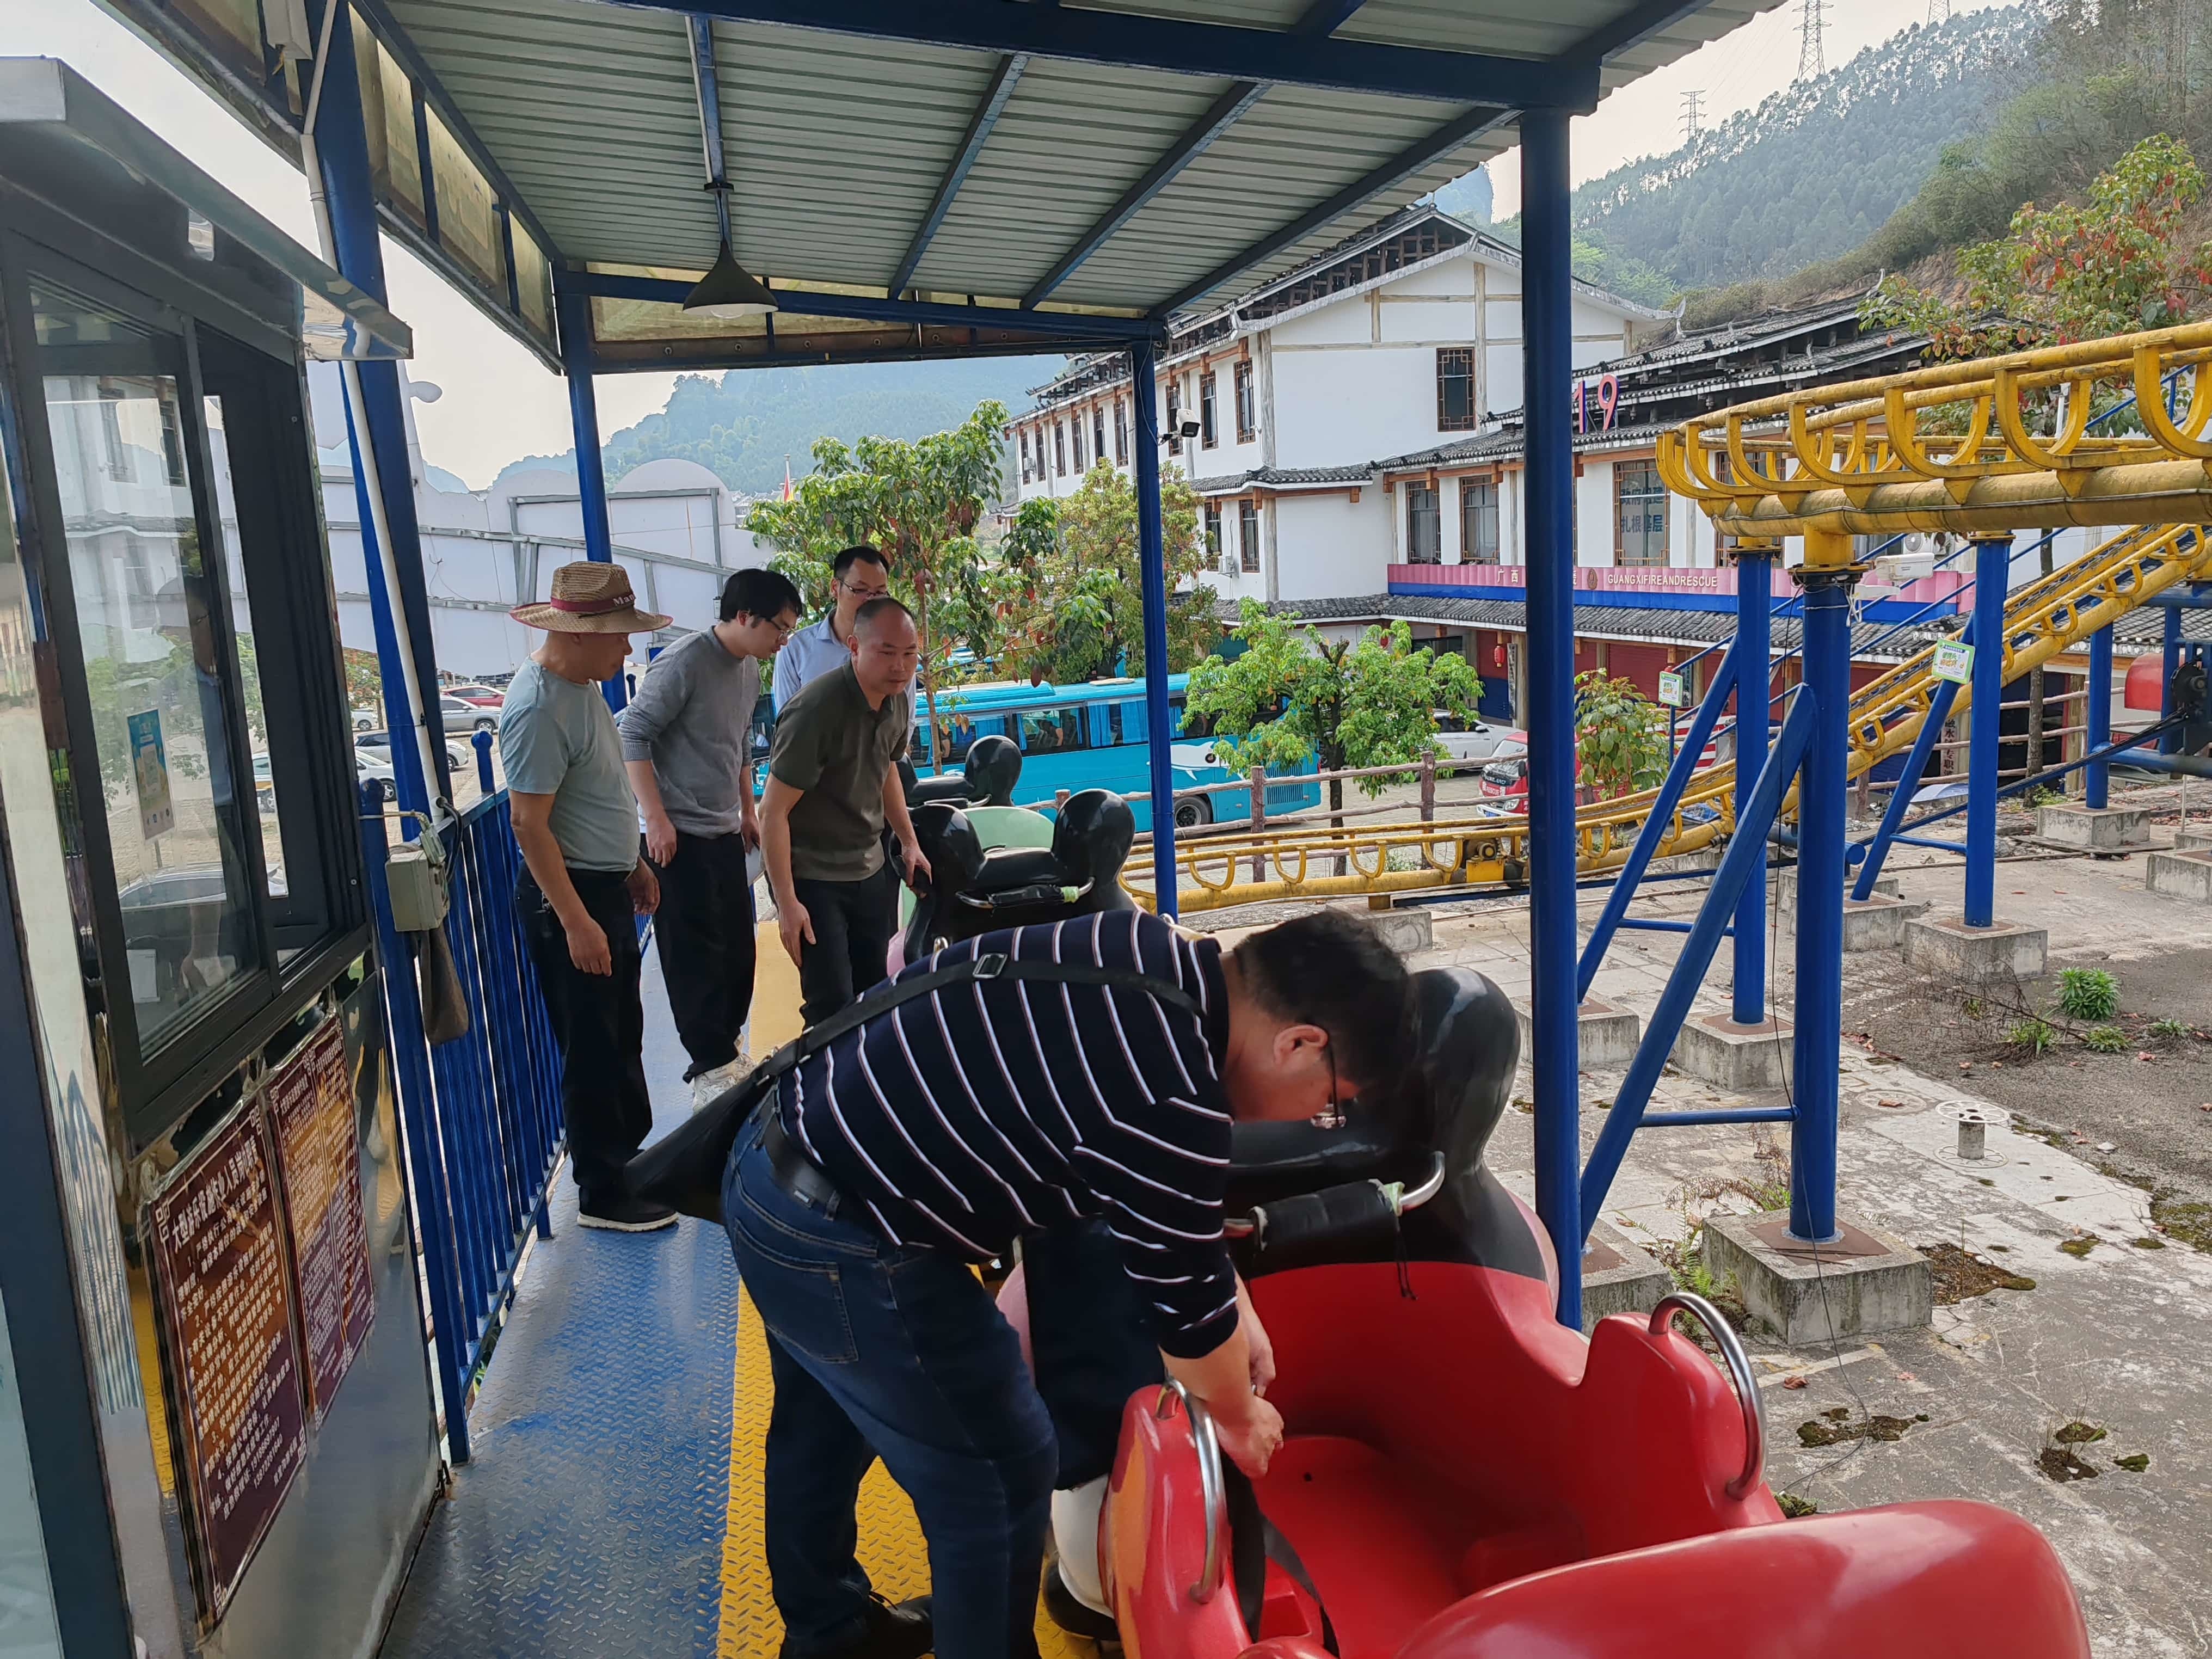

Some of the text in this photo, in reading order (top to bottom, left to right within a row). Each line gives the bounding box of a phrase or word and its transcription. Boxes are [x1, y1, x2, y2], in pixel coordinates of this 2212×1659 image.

[1621, 514, 1663, 533] 扎根基层
[1497, 568, 1717, 587] 广西 GUANGXIFIREANDRESCUE
